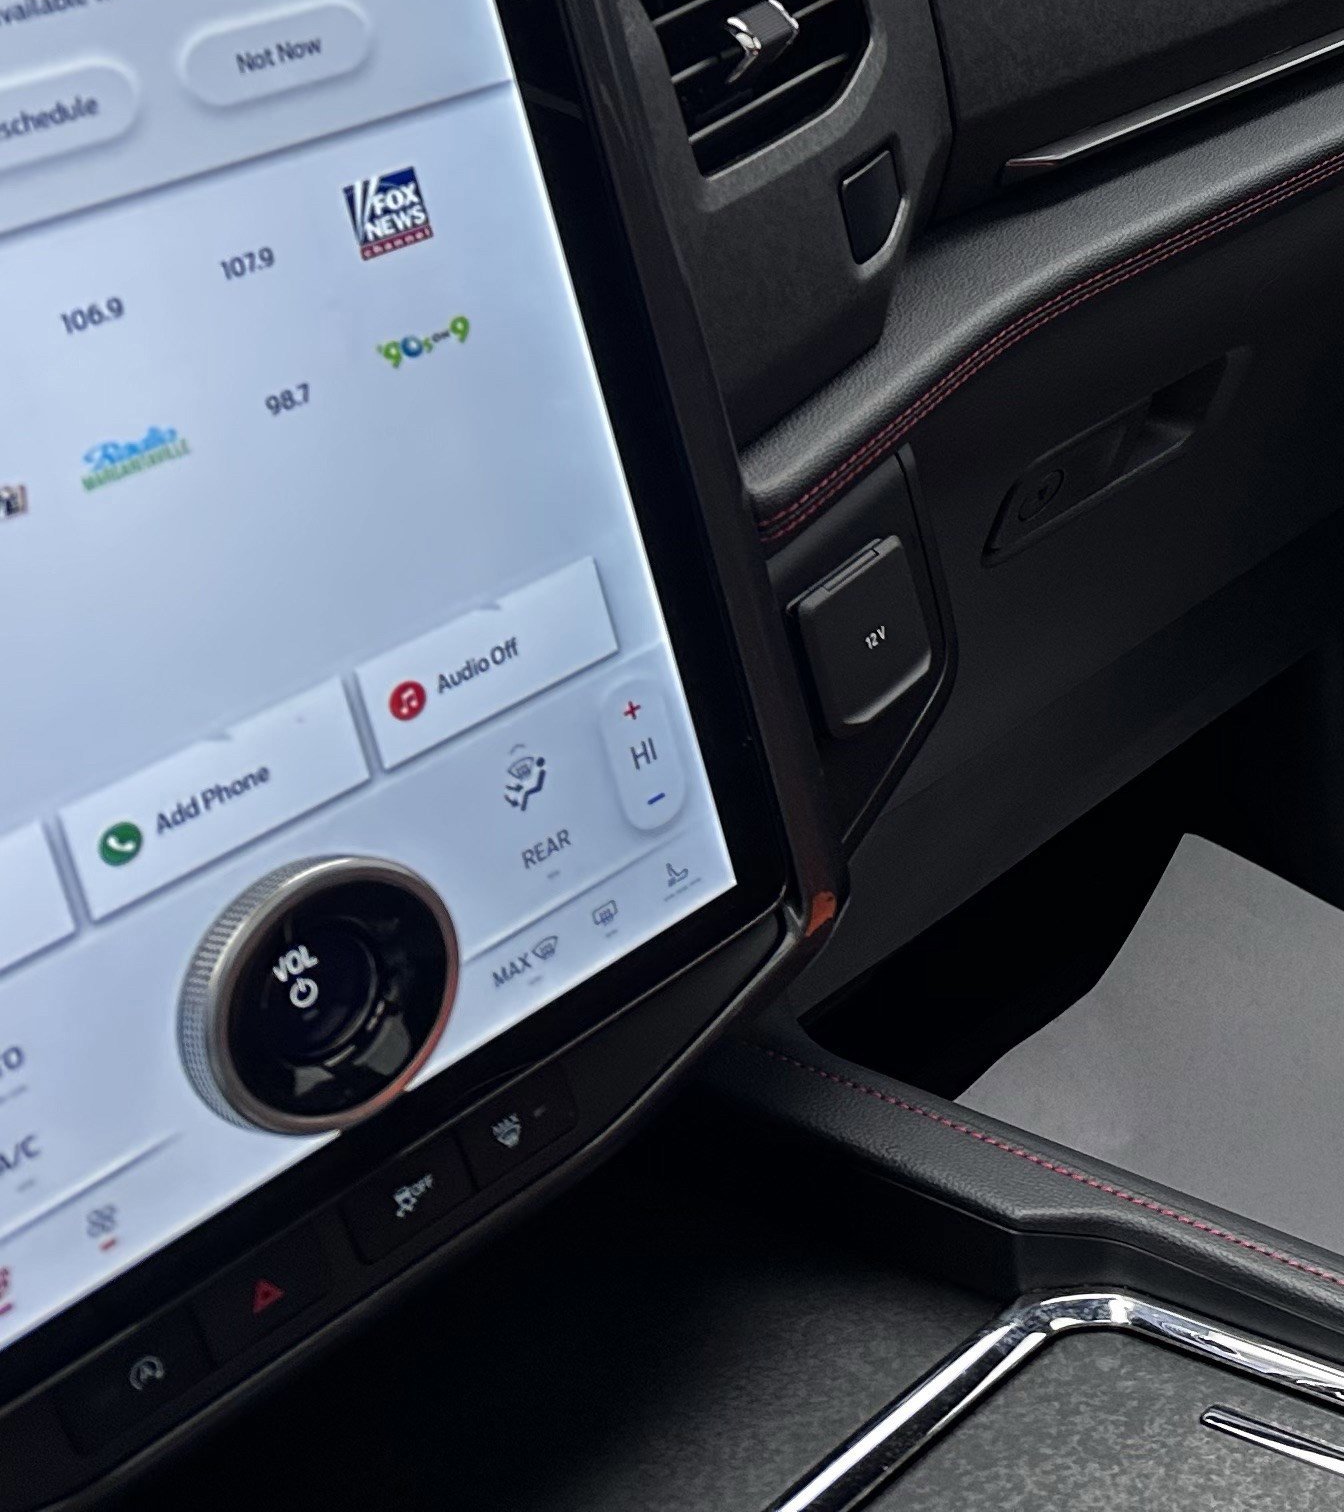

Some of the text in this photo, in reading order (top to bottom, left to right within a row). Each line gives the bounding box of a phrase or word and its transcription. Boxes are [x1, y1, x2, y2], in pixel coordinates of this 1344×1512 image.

[236, 38, 323, 75] Not Now
[372, 182, 420, 216] FOX
[364, 204, 427, 242] NEWS
[220, 245, 276, 281] 107.9
[60, 296, 125, 334] 106.9
[449, 314, 471, 345] 9
[264, 383, 312, 418] 98.7
[436, 636, 521, 696] Audio Off
[629, 736, 658, 771] HI
[155, 763, 272, 836] Add Phone
[521, 828, 573, 871] REAR
[272, 943, 320, 984] VOL
[492, 952, 534, 990] MAX
